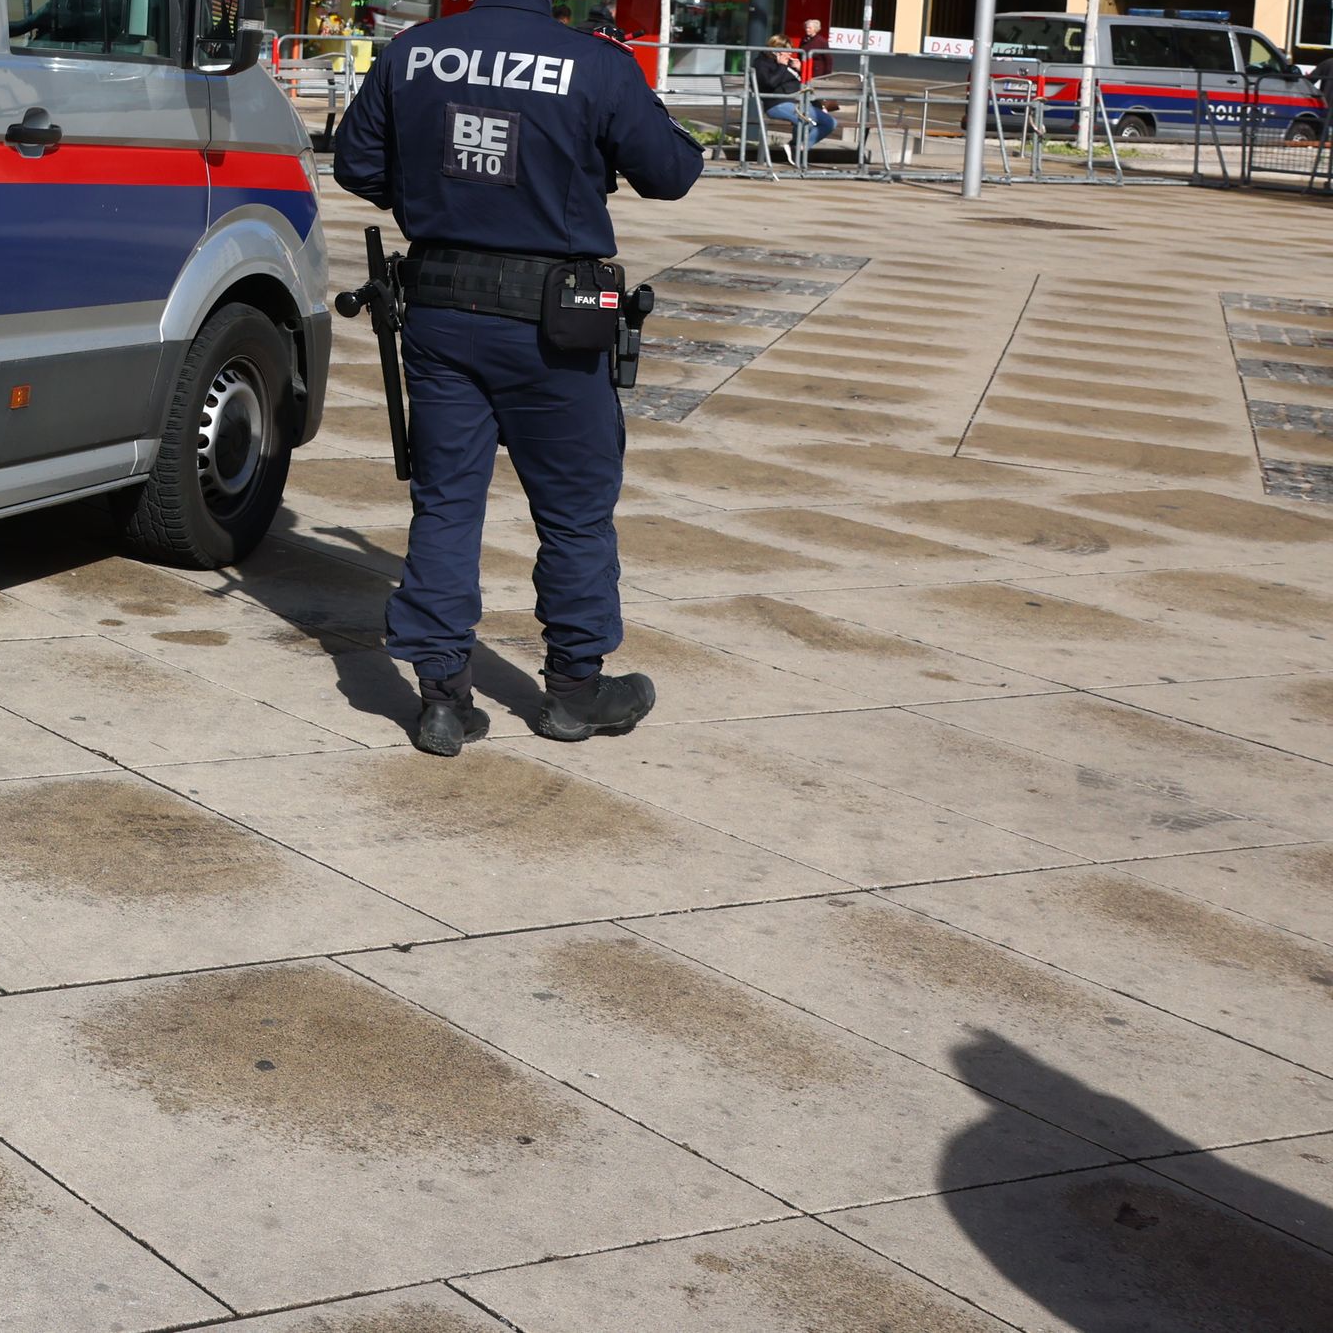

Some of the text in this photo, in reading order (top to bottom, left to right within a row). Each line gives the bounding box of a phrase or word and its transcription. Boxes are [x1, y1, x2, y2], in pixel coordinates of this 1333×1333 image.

[931, 41, 962, 54] DAS
[406, 46, 574, 95] POLIZEI
[453, 113, 509, 151] BE
[457, 151, 501, 175] 110
[574, 295, 596, 305] IFAK
